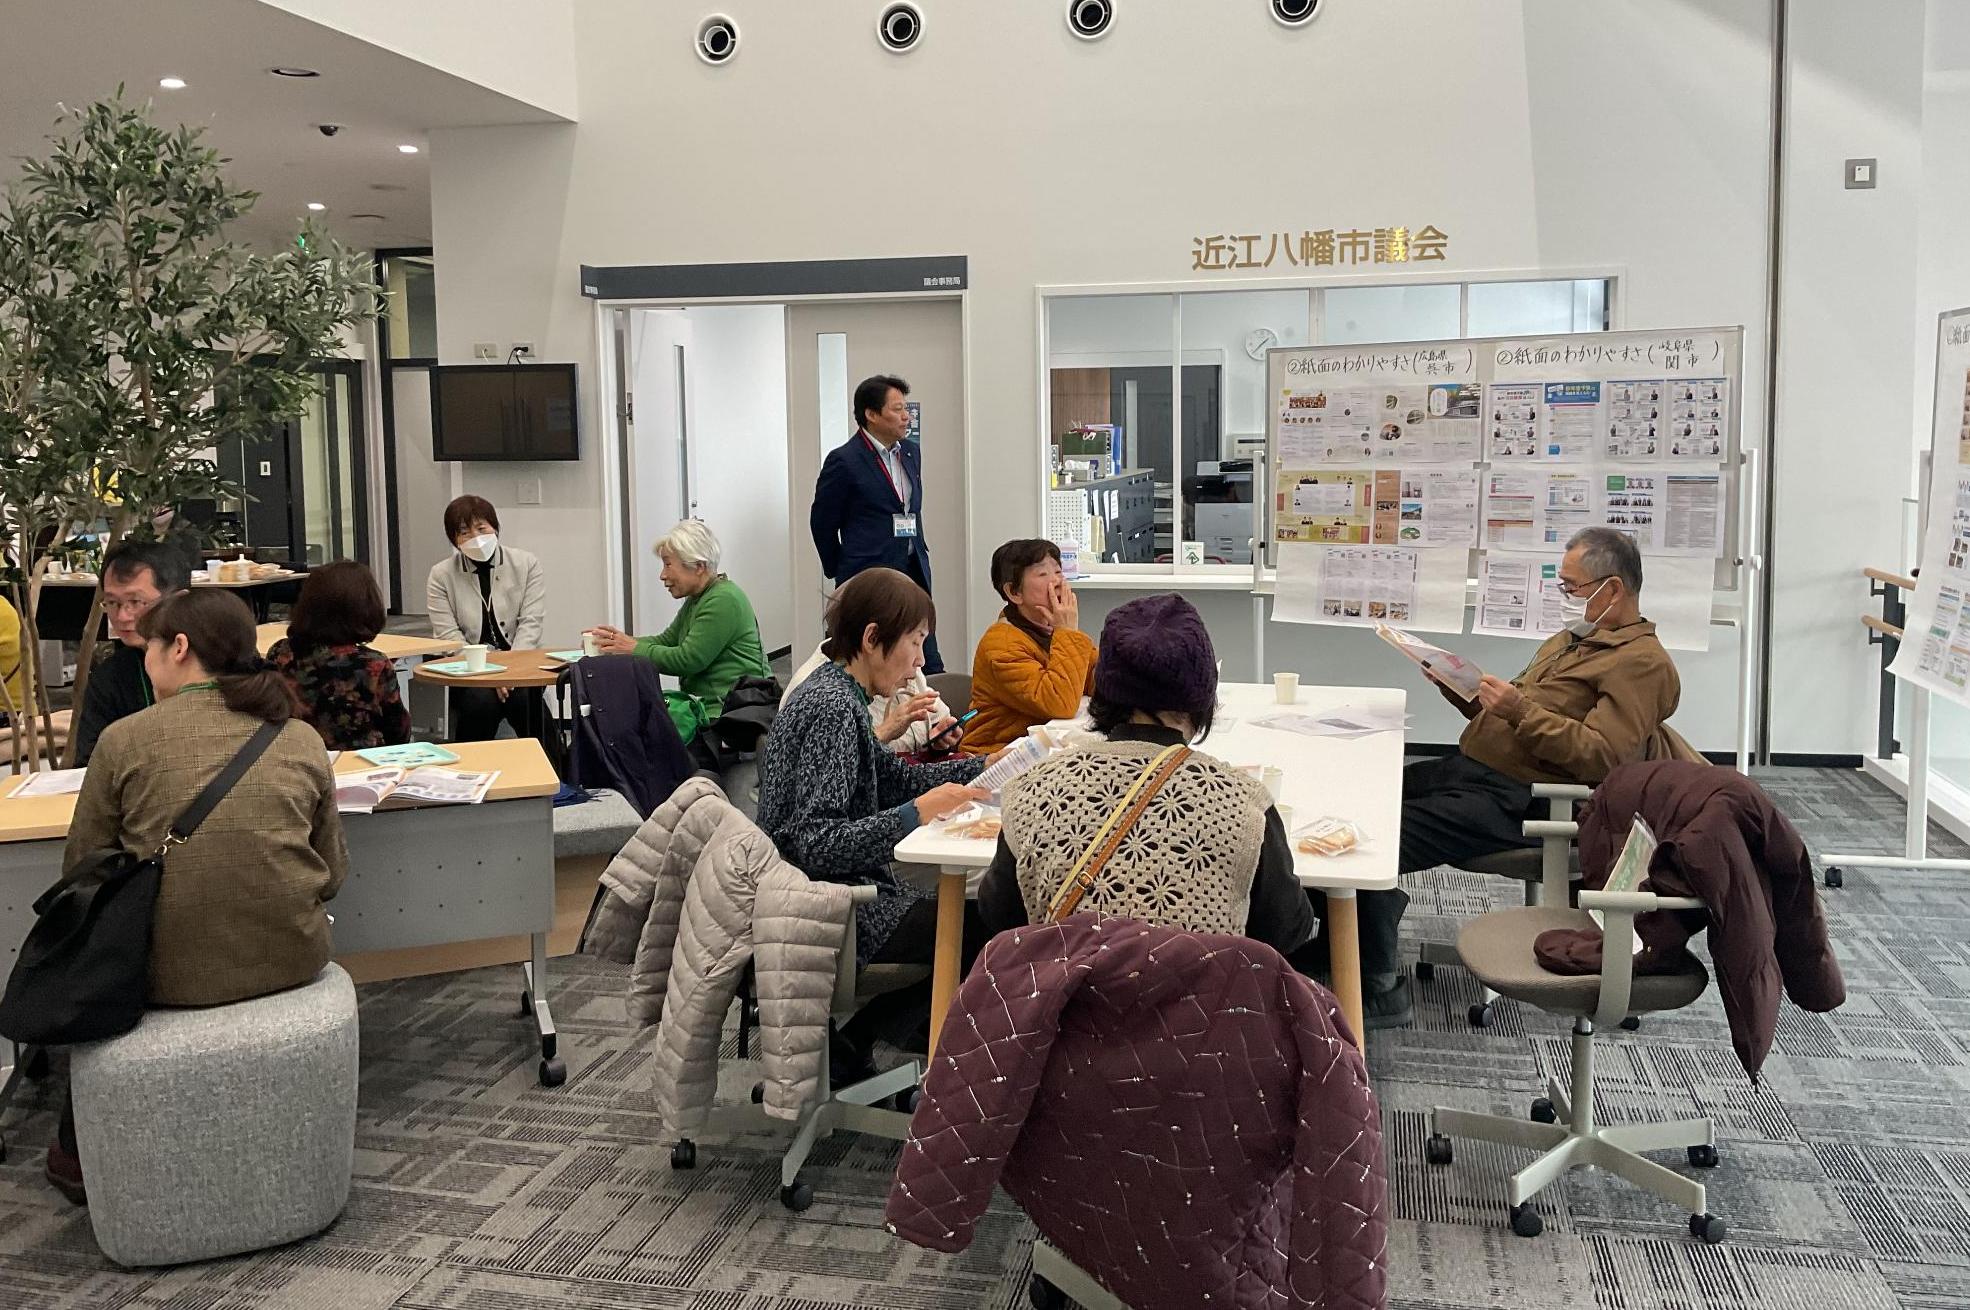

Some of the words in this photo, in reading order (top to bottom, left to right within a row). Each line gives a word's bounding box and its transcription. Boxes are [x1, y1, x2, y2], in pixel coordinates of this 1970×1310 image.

[1192, 225, 1449, 271] 近江八幡市議会
